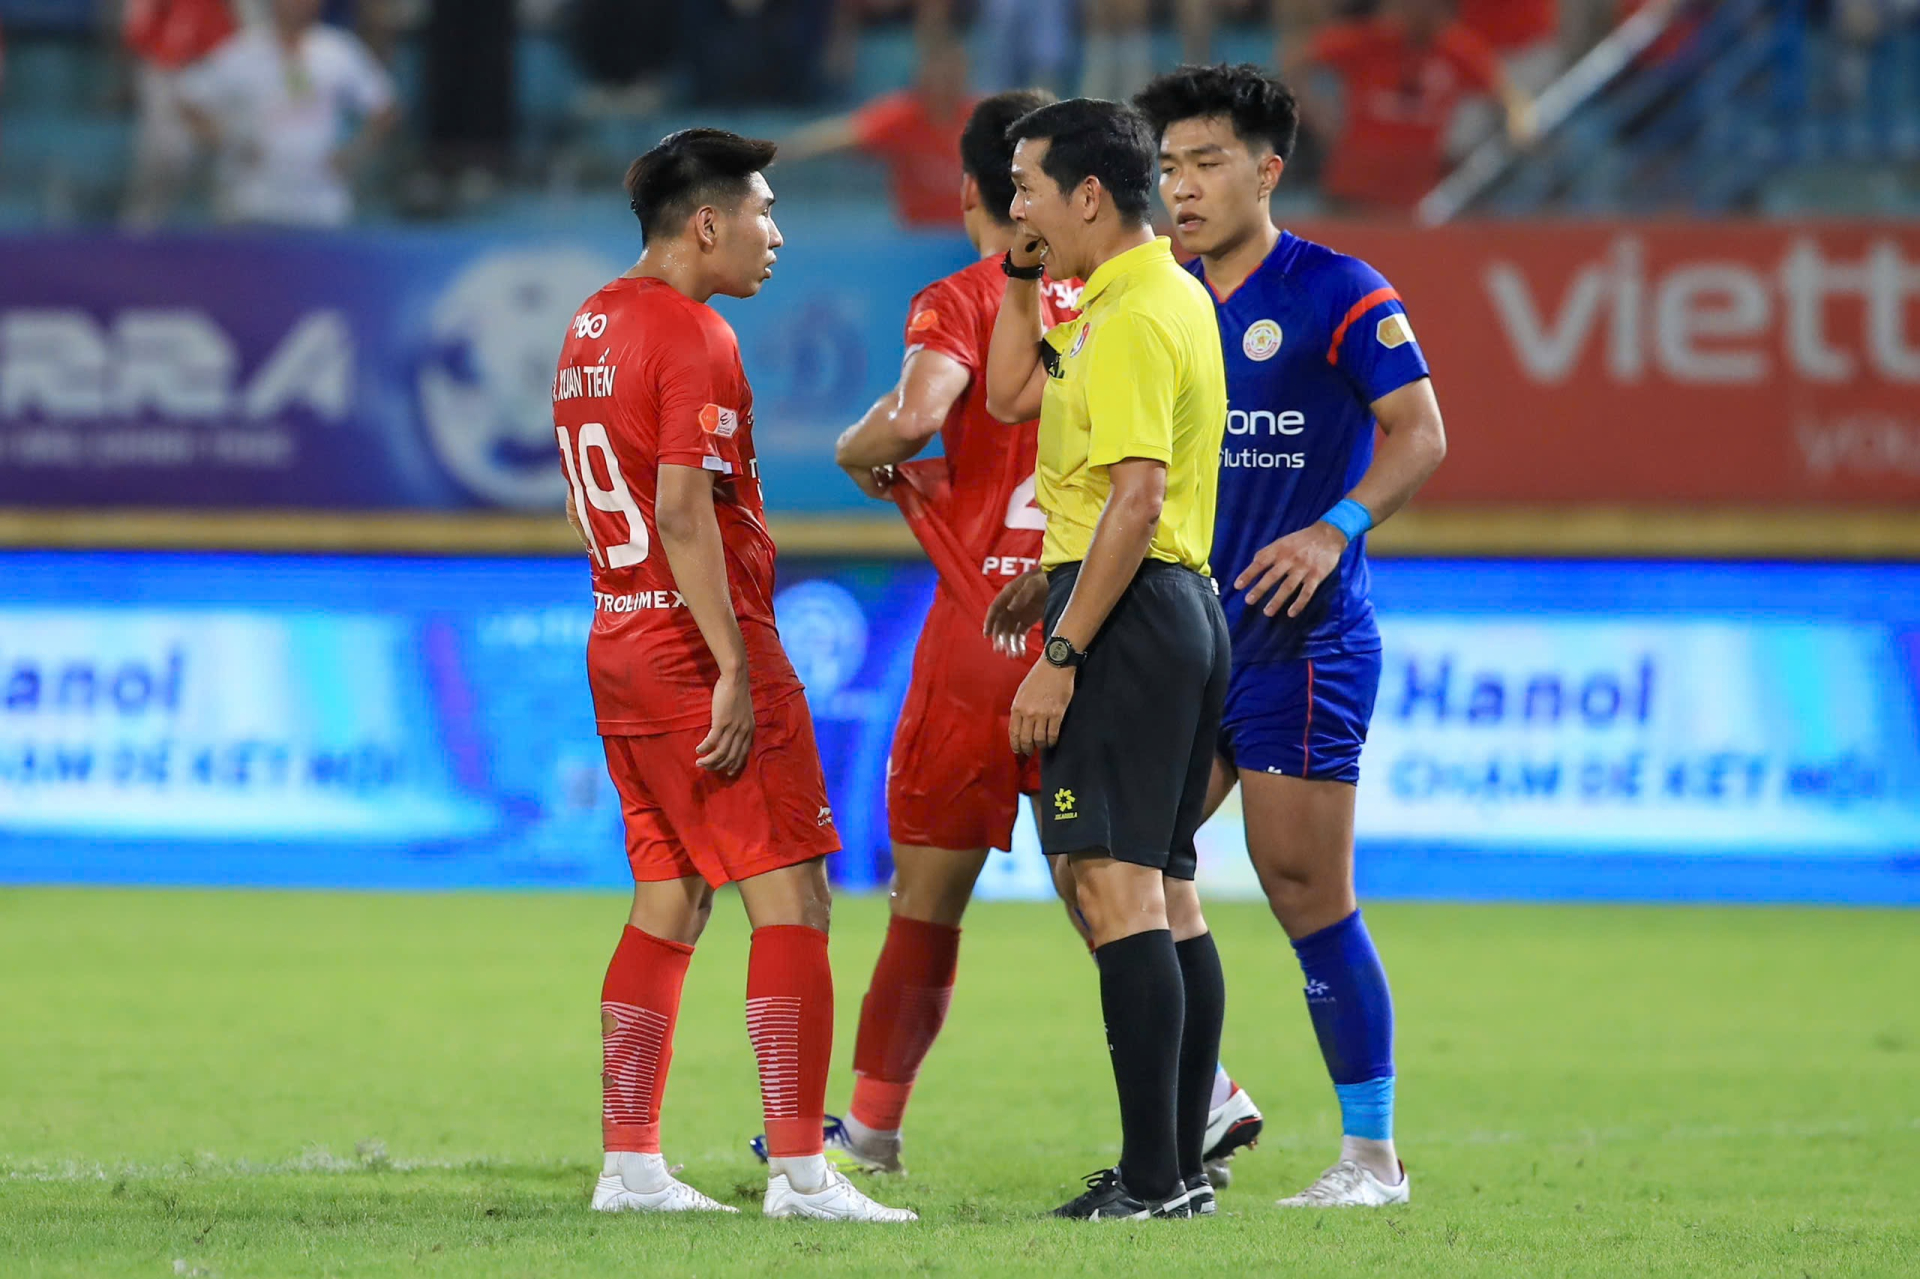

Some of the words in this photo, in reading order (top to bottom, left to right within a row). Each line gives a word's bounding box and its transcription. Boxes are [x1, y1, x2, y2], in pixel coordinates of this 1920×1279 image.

[583, 347, 617, 398] TIẾN
[1226, 409, 1305, 436] one
[556, 422, 650, 570] 19
[982, 556, 1042, 576] PET
